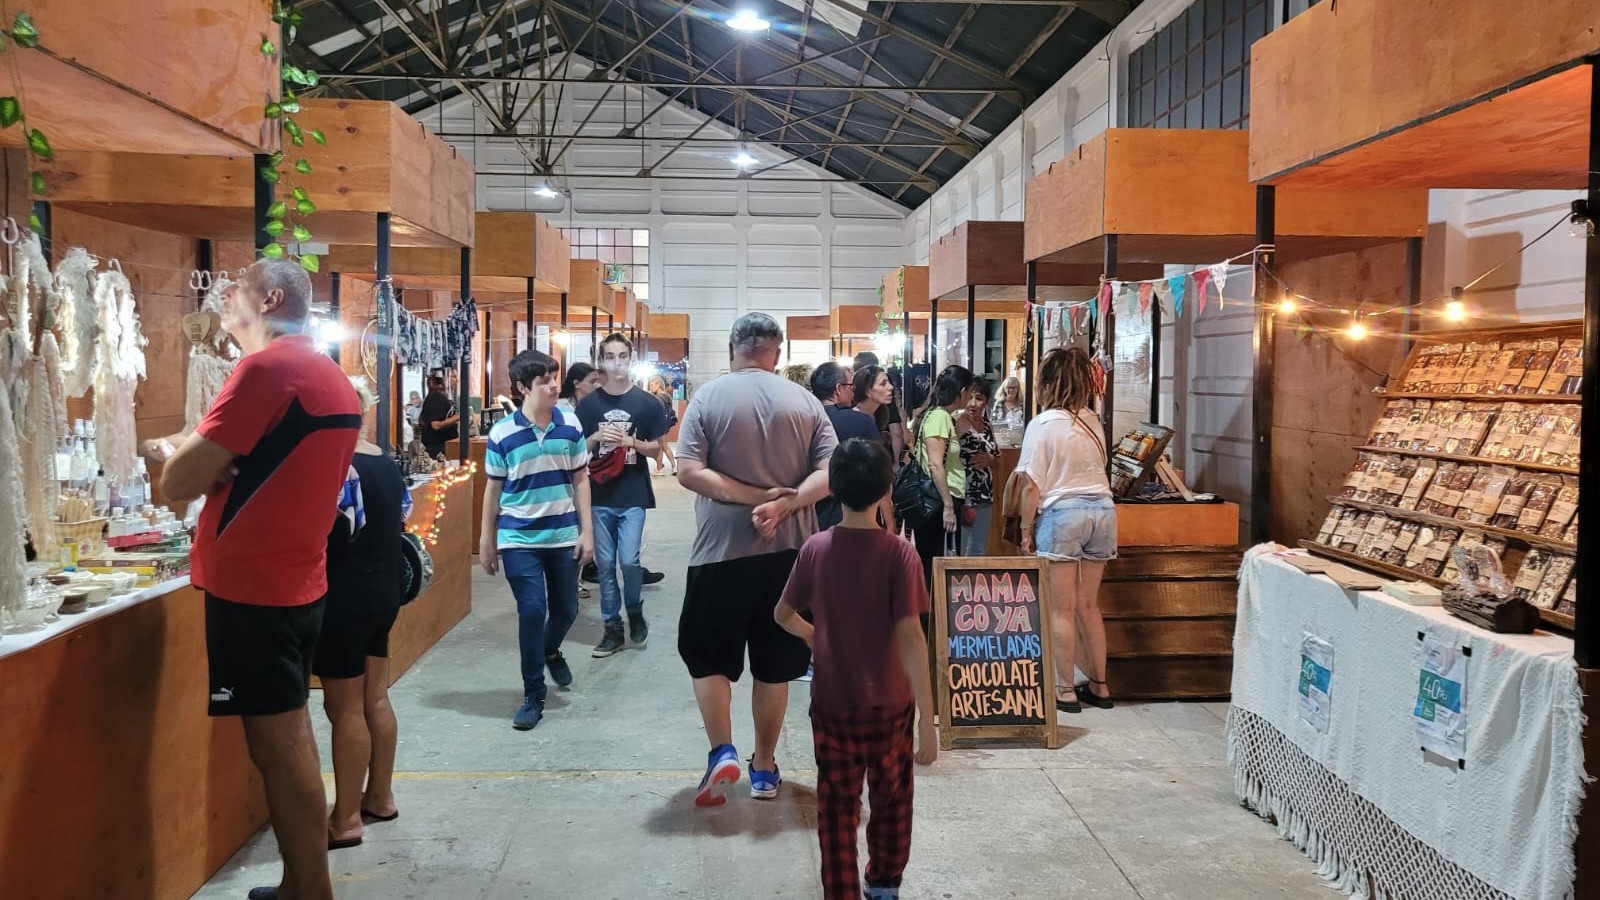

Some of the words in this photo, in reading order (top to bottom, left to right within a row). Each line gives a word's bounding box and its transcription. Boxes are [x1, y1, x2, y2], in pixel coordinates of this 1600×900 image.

[951, 572, 1036, 603] MAMA
[948, 634, 1041, 660] MERMELADAS
[948, 659, 1040, 690] CHOCOLATE
[1422, 676, 1448, 700] 40%
[951, 686, 1045, 719] ARTESANAL
